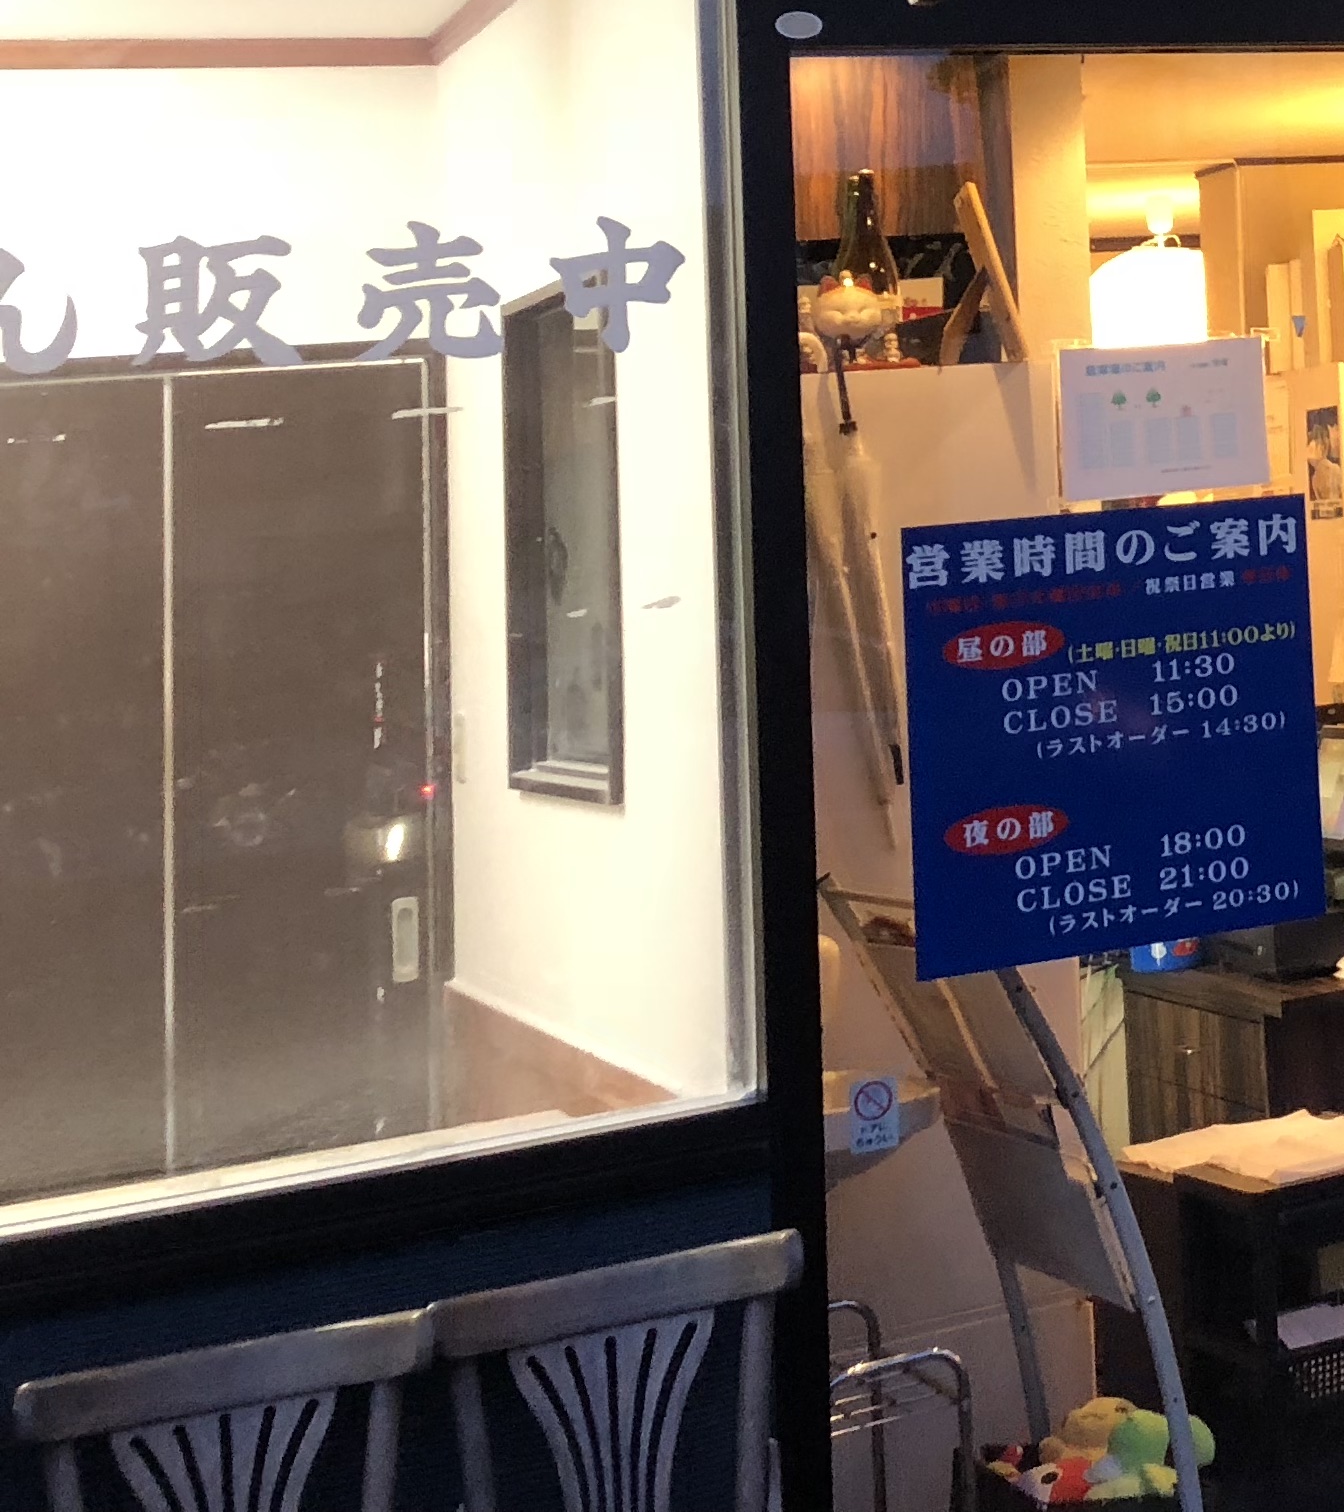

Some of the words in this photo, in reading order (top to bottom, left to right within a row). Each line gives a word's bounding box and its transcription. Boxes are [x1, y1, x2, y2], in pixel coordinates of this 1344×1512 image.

[905, 513, 1298, 591] 営業時間のご案内
[1145, 571, 1236, 596] 祝祭日営業
[957, 629, 1048, 663] 昼の部
[1002, 670, 1099, 702] OPEN
[1152, 652, 1236, 683] 11:30
[1003, 700, 1118, 735] CLOSE
[1150, 684, 1239, 716] 15:00
[963, 811, 1055, 847] 夜の部
[1015, 845, 1112, 881] OPEN
[1159, 824, 1247, 858] 18:00
[1016, 874, 1132, 913] CLOSE
[1159, 856, 1250, 891] 21:00
